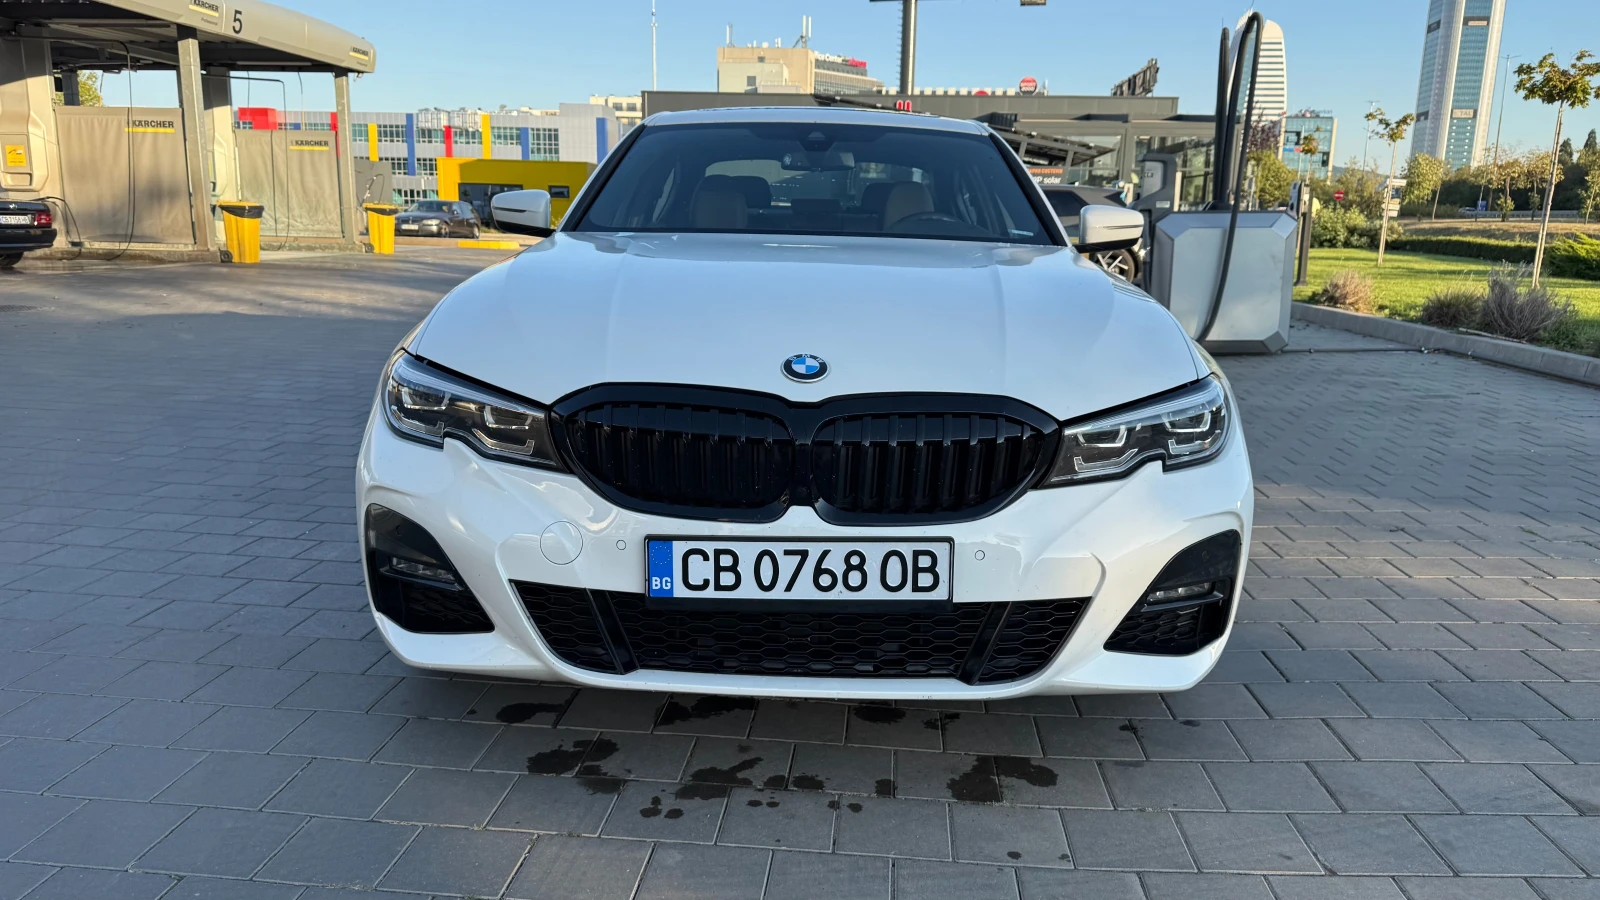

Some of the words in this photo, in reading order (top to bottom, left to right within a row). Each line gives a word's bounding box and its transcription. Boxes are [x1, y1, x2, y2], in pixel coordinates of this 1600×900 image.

[232, 9, 243, 34] 5
[1044, 176, 1061, 184] solar
[681, 548, 742, 592] CB
[753, 549, 868, 593] 0768
[880, 549, 940, 593] OB
[652, 577, 671, 590] BG
